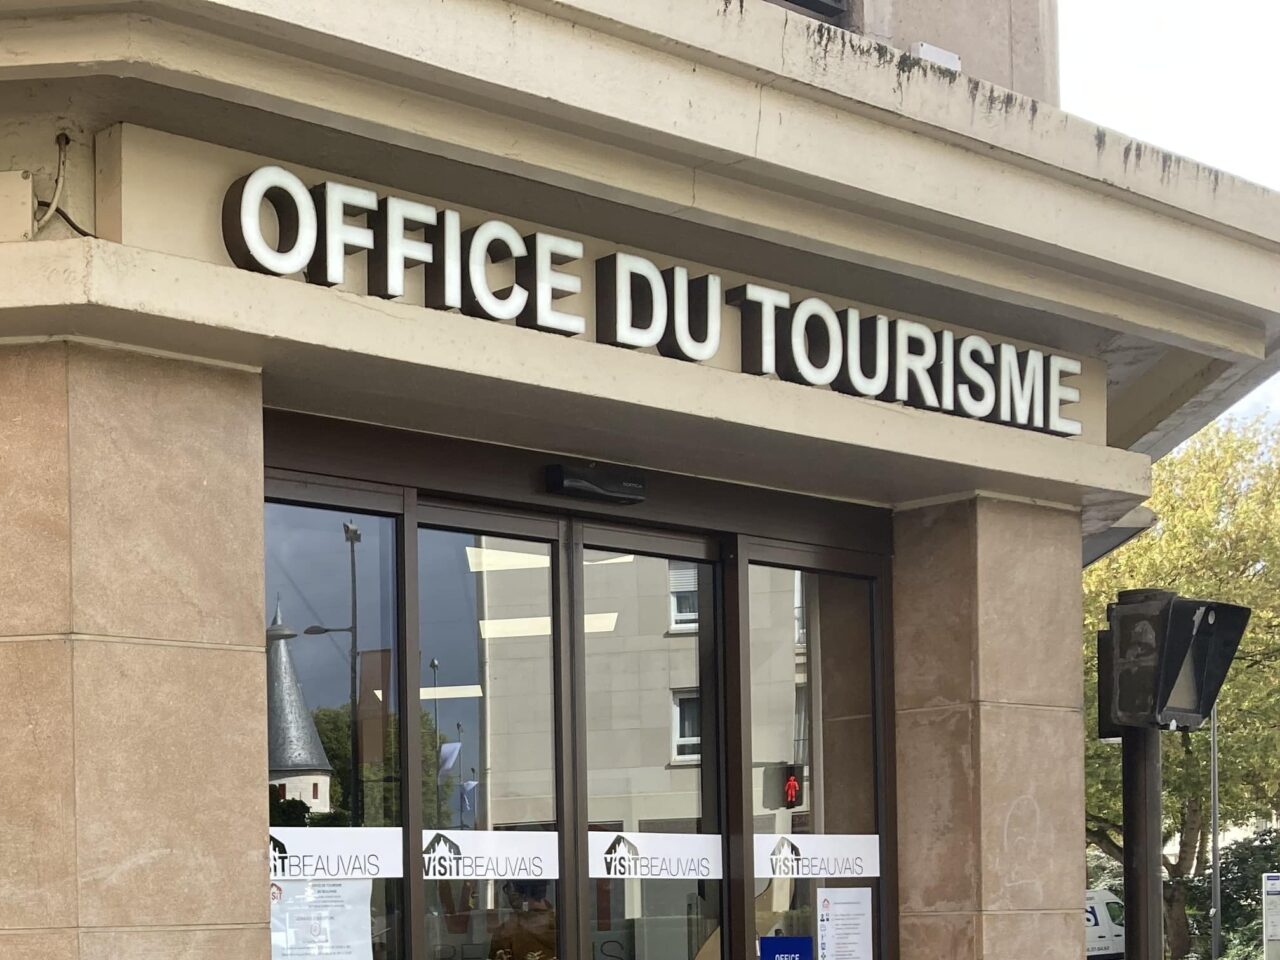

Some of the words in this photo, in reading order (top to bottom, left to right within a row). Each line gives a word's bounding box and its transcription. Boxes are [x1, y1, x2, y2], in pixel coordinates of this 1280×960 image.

[238, 164, 586, 337] OFFICE
[614, 251, 721, 362] DU
[744, 282, 1082, 437] TOURISME
